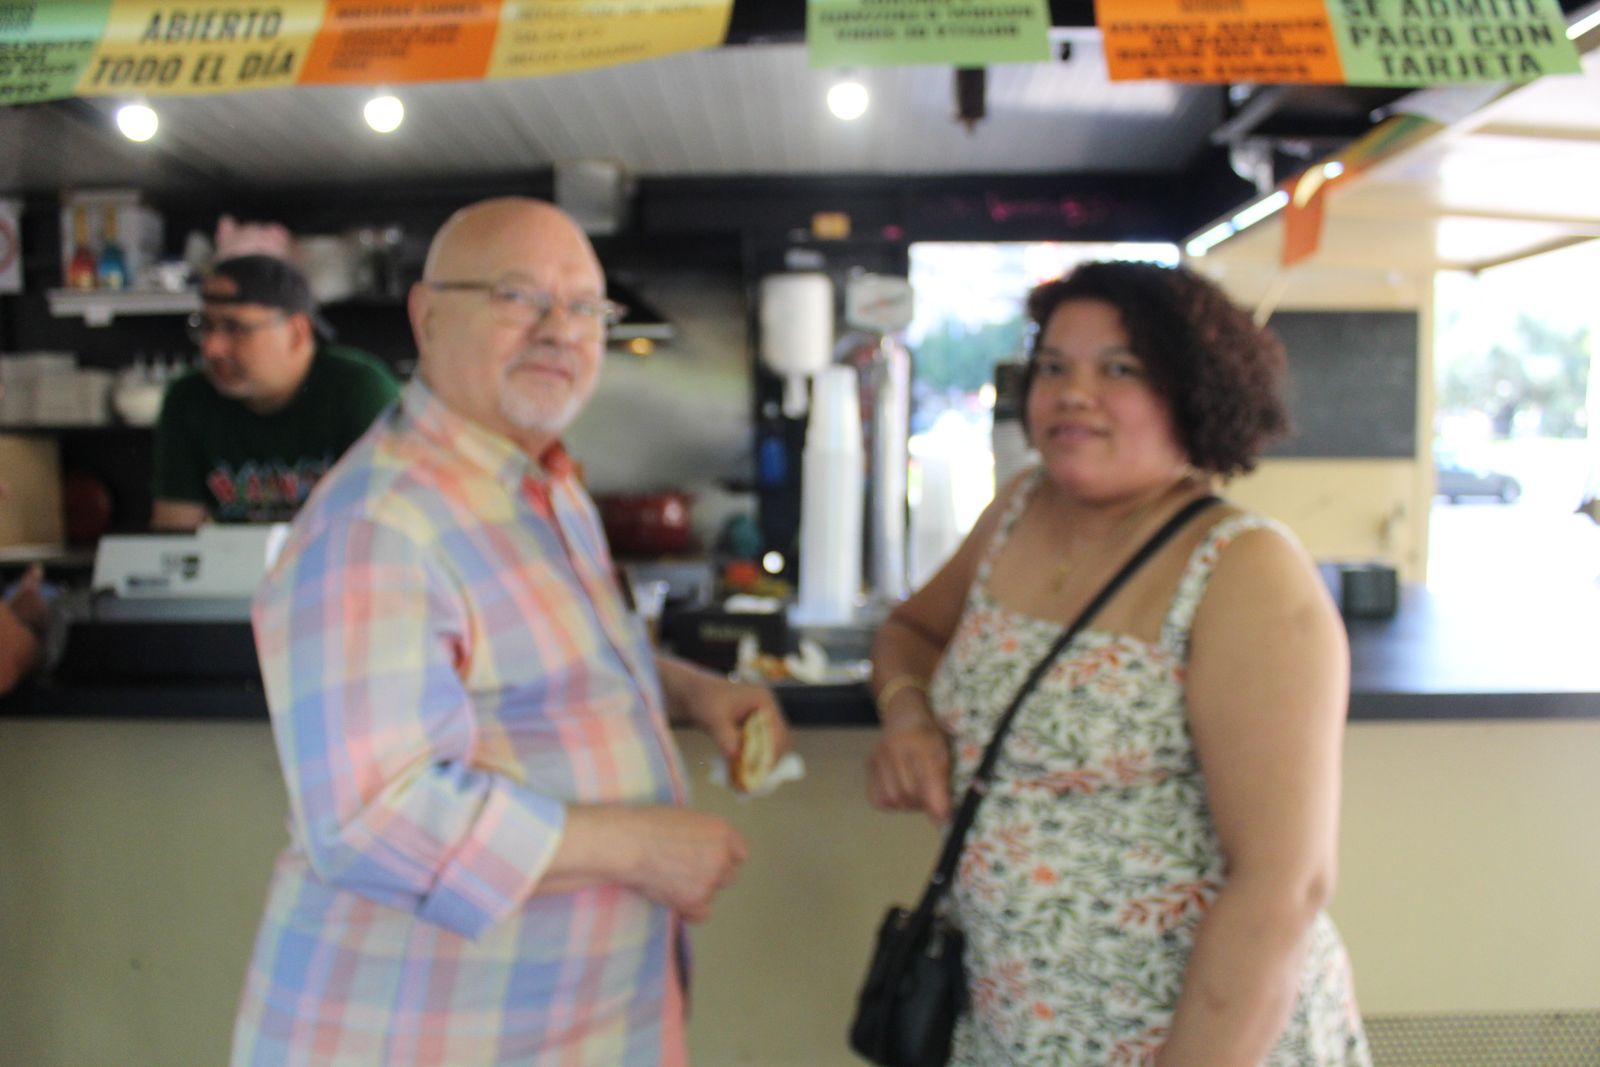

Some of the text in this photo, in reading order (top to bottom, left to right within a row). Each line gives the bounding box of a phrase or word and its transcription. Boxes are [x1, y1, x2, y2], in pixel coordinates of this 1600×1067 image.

[1342, 0, 1541, 18] SE ADMITE
[142, 8, 282, 43] ABIERTO
[1349, 25, 1453, 47] PAGO
[1471, 24, 1554, 46] CON
[92, 54, 183, 85] TODO
[190, 54, 225, 84] EL
[237, 44, 295, 81] DÍA
[1380, 54, 1543, 77] TARJETA
